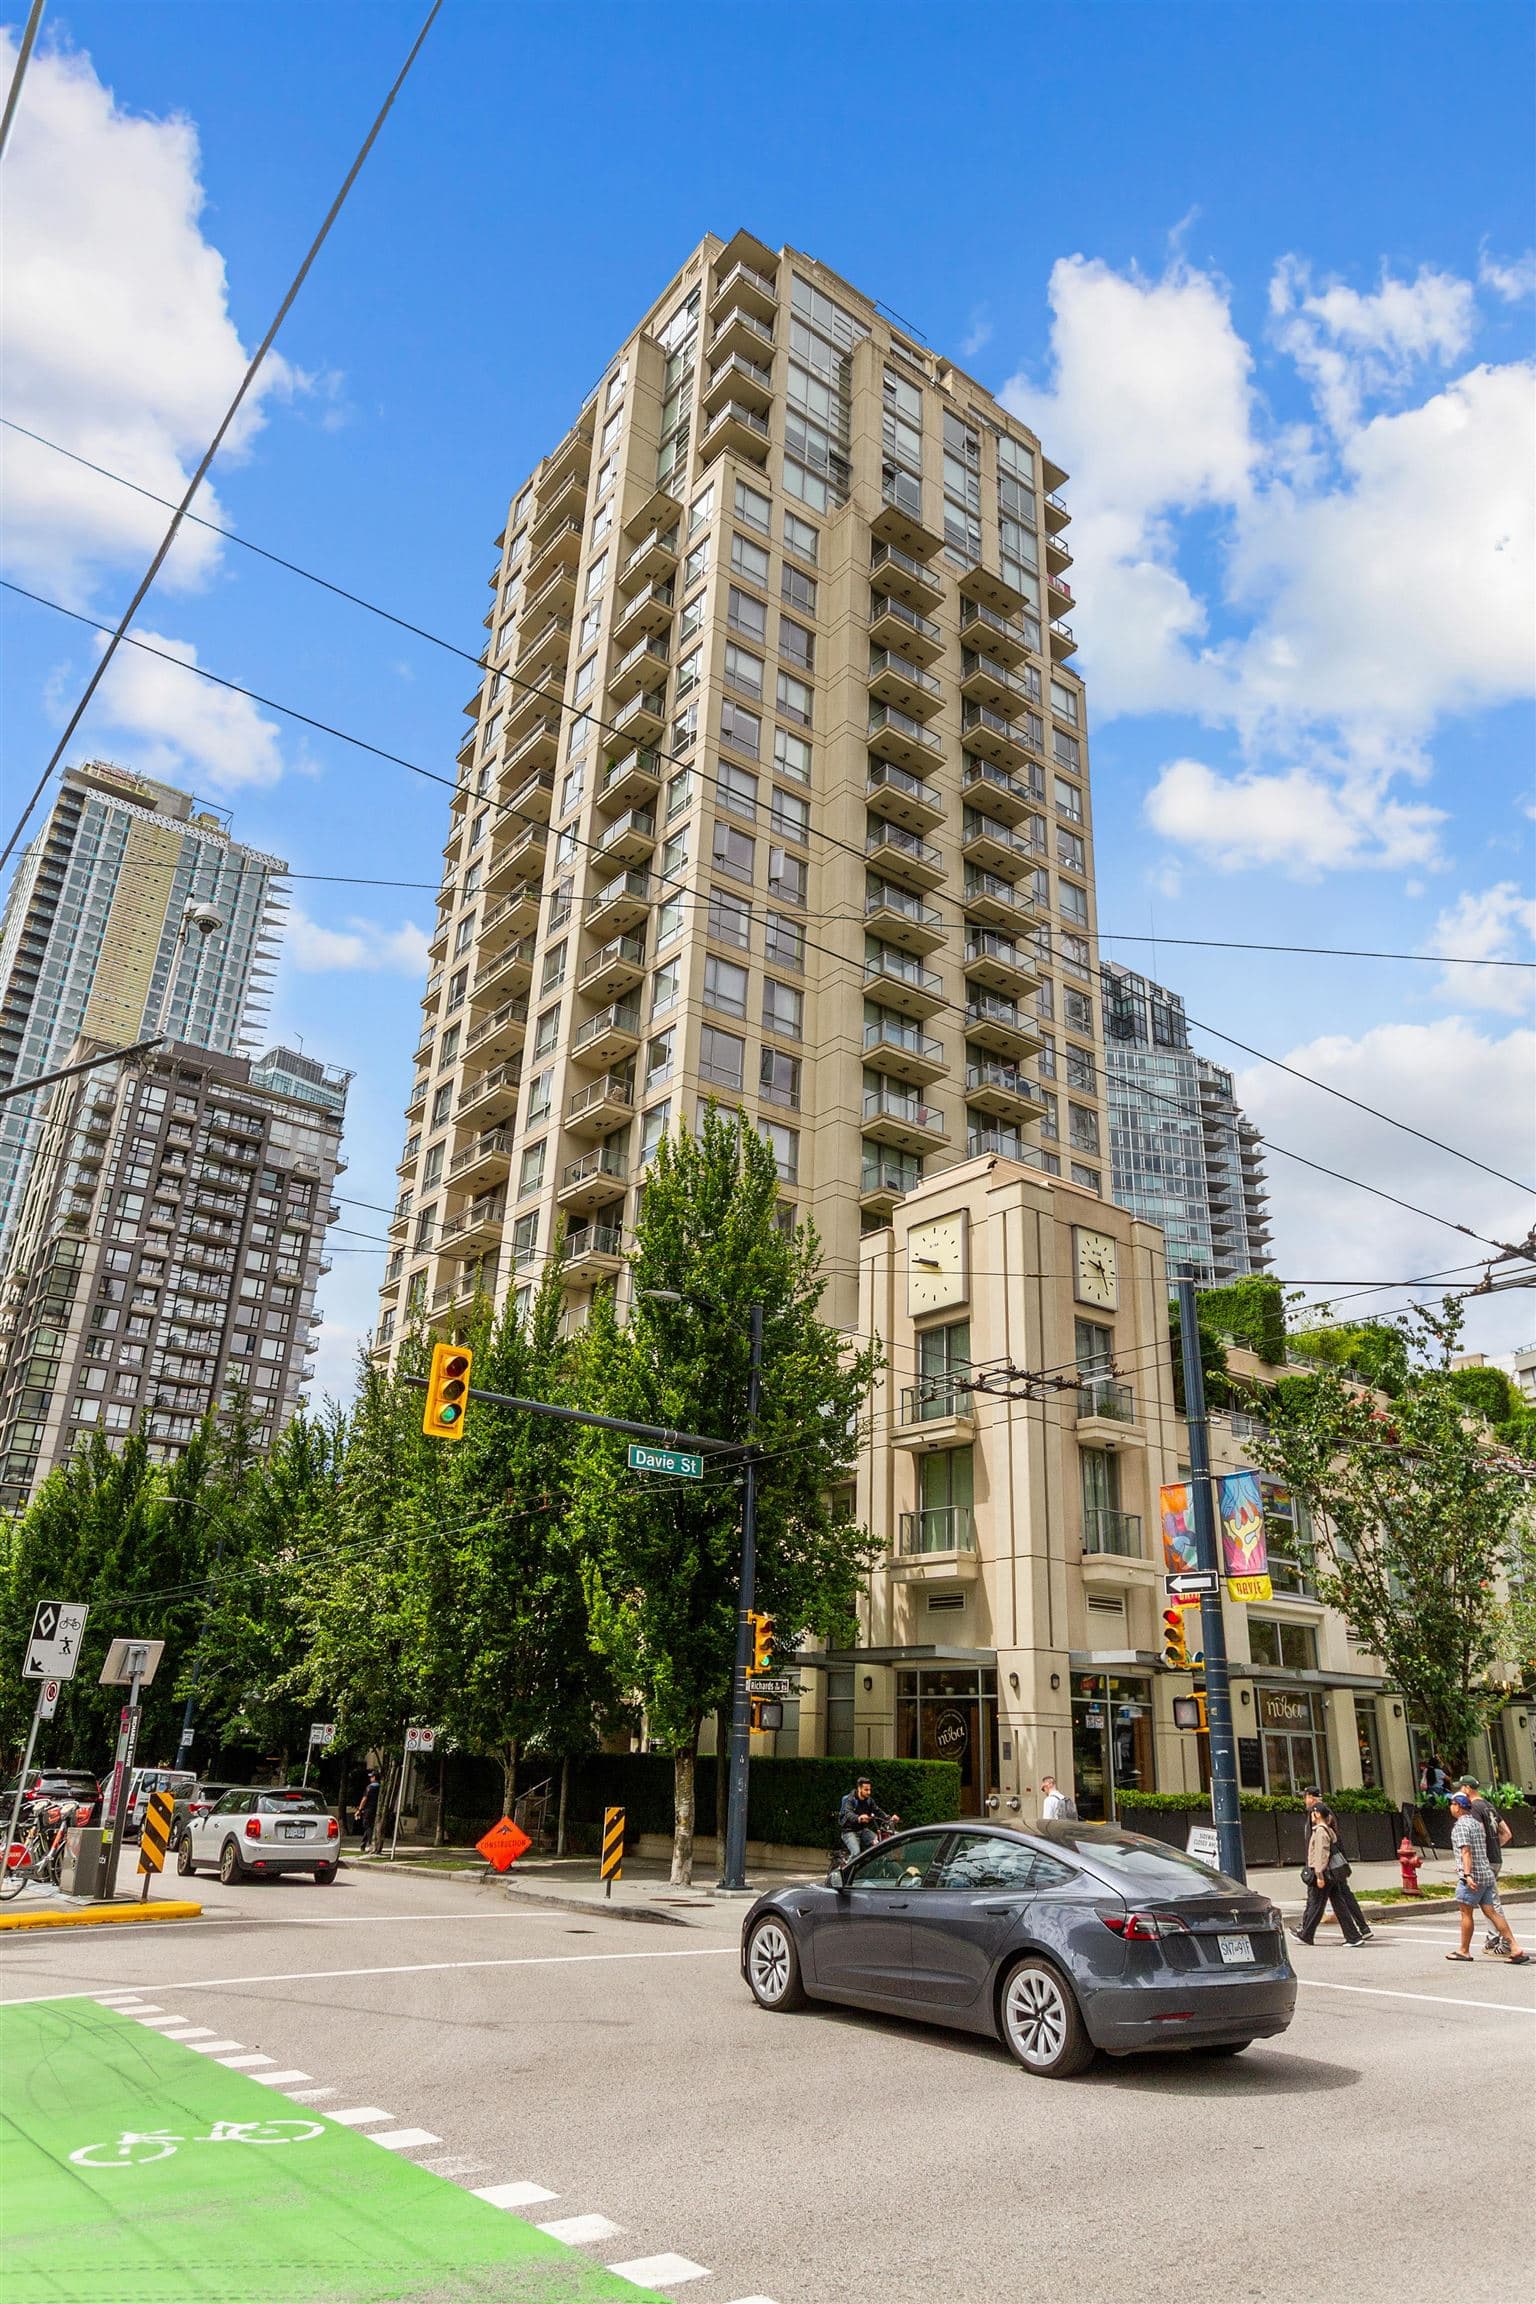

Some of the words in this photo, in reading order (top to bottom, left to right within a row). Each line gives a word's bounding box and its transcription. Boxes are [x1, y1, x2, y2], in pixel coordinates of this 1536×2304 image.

[636, 1450, 675, 1470] Davie
[680, 1457, 697, 1474] St
[1236, 1581, 1263, 1595] DAVIE
[750, 1681, 774, 1691] Richards
[129, 1716, 137, 1745] RICHARDS
[480, 1839, 527, 1849] CONSTRUCTION
